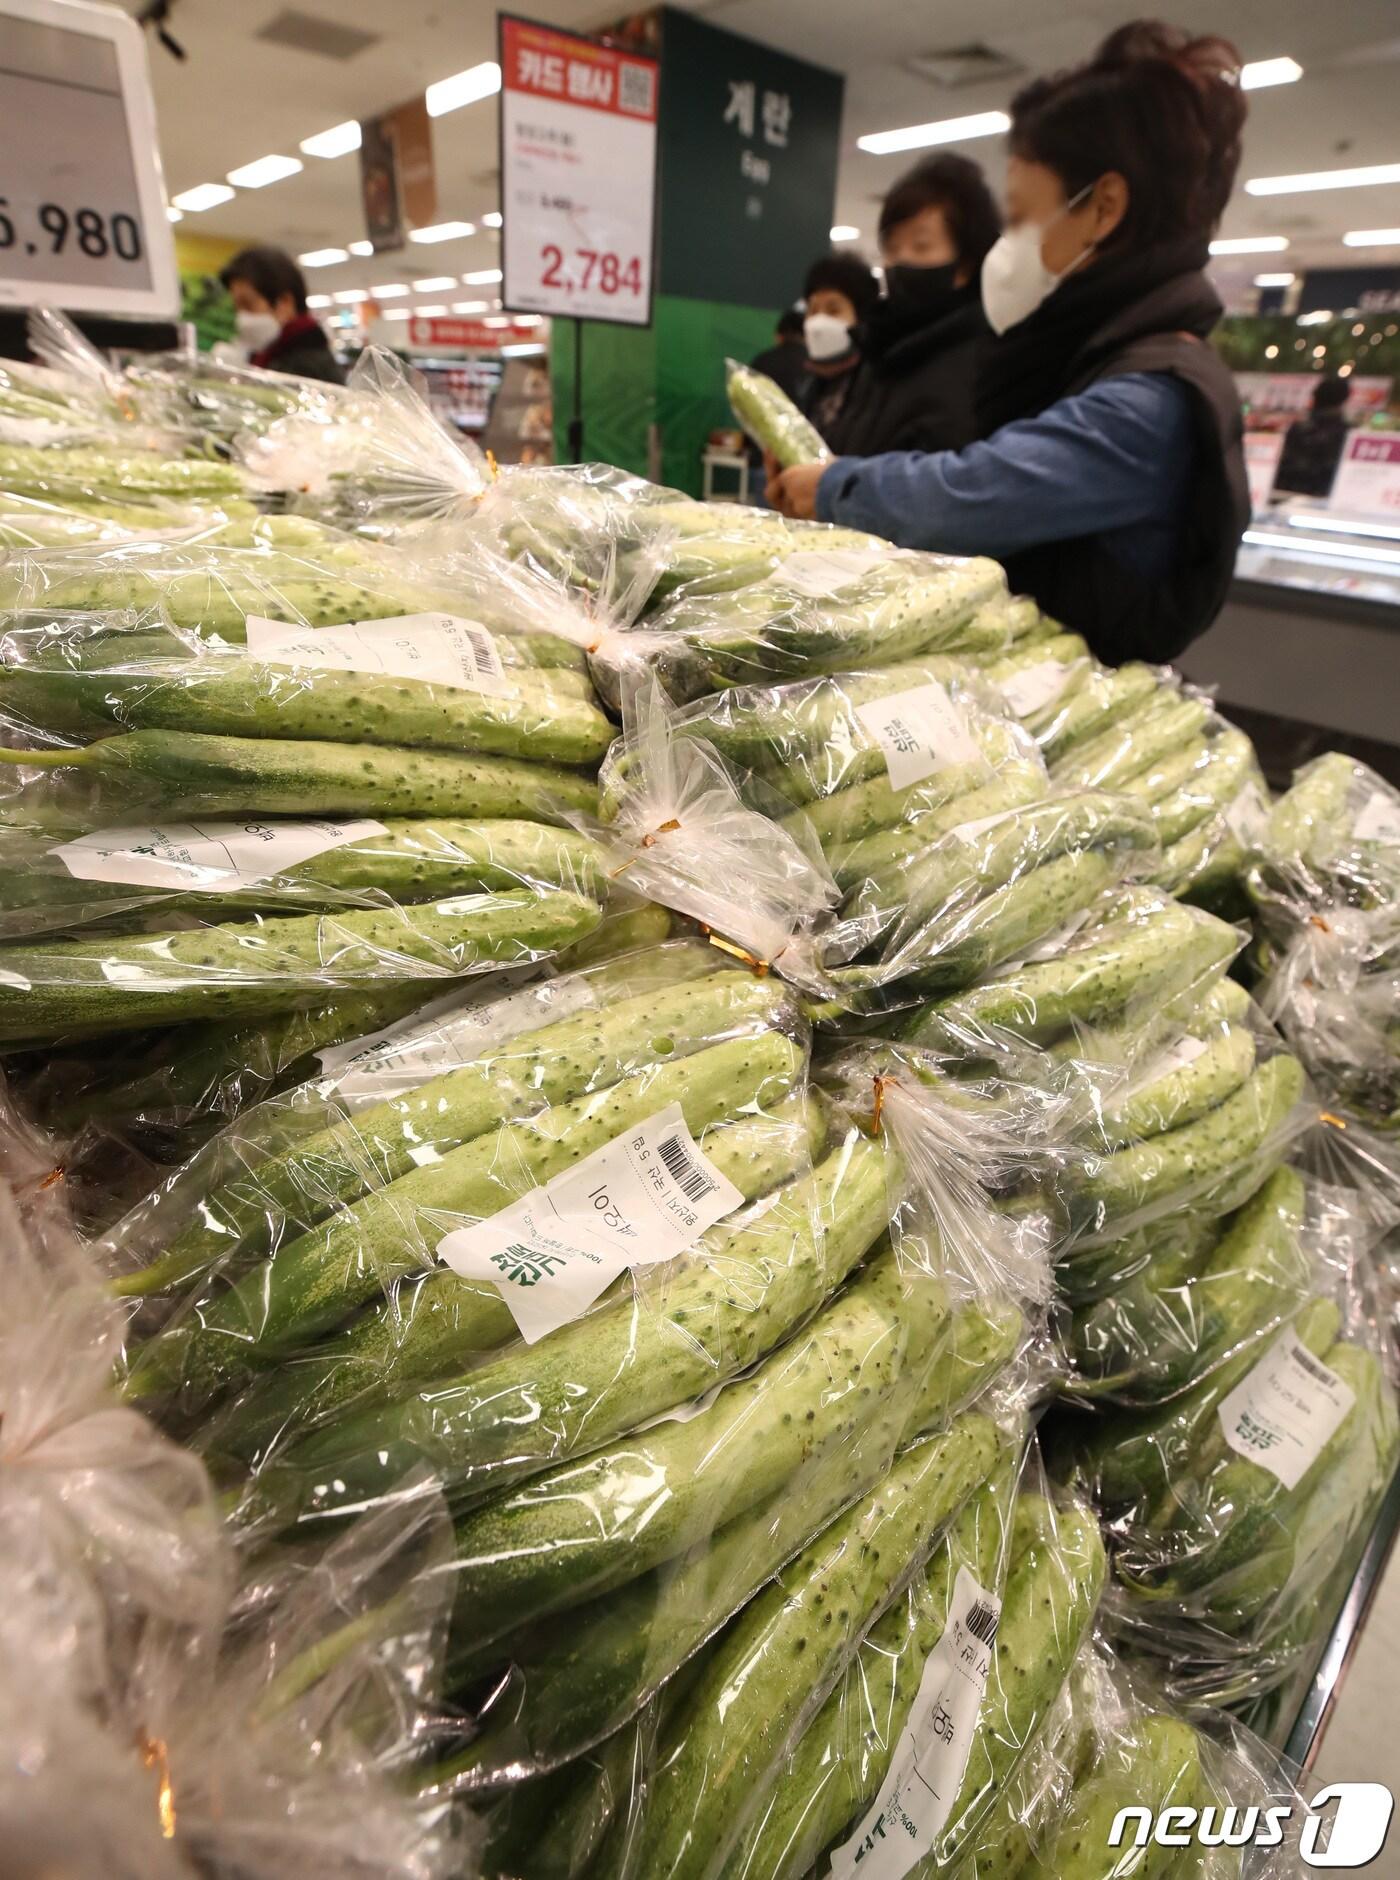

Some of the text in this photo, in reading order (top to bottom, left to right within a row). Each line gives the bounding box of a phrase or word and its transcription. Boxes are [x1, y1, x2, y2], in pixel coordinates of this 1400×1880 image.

[517, 47, 563, 93] 카드
[724, 80, 791, 147] 계란
[541, 244, 643, 297] 2,784
[647, 1165, 665, 1191] 국산
[666, 1195, 699, 1226] 원산지
[490, 1253, 542, 1287] 신선
[506, 1243, 567, 1277] 그대로
[900, 1813, 918, 1839] 100%
